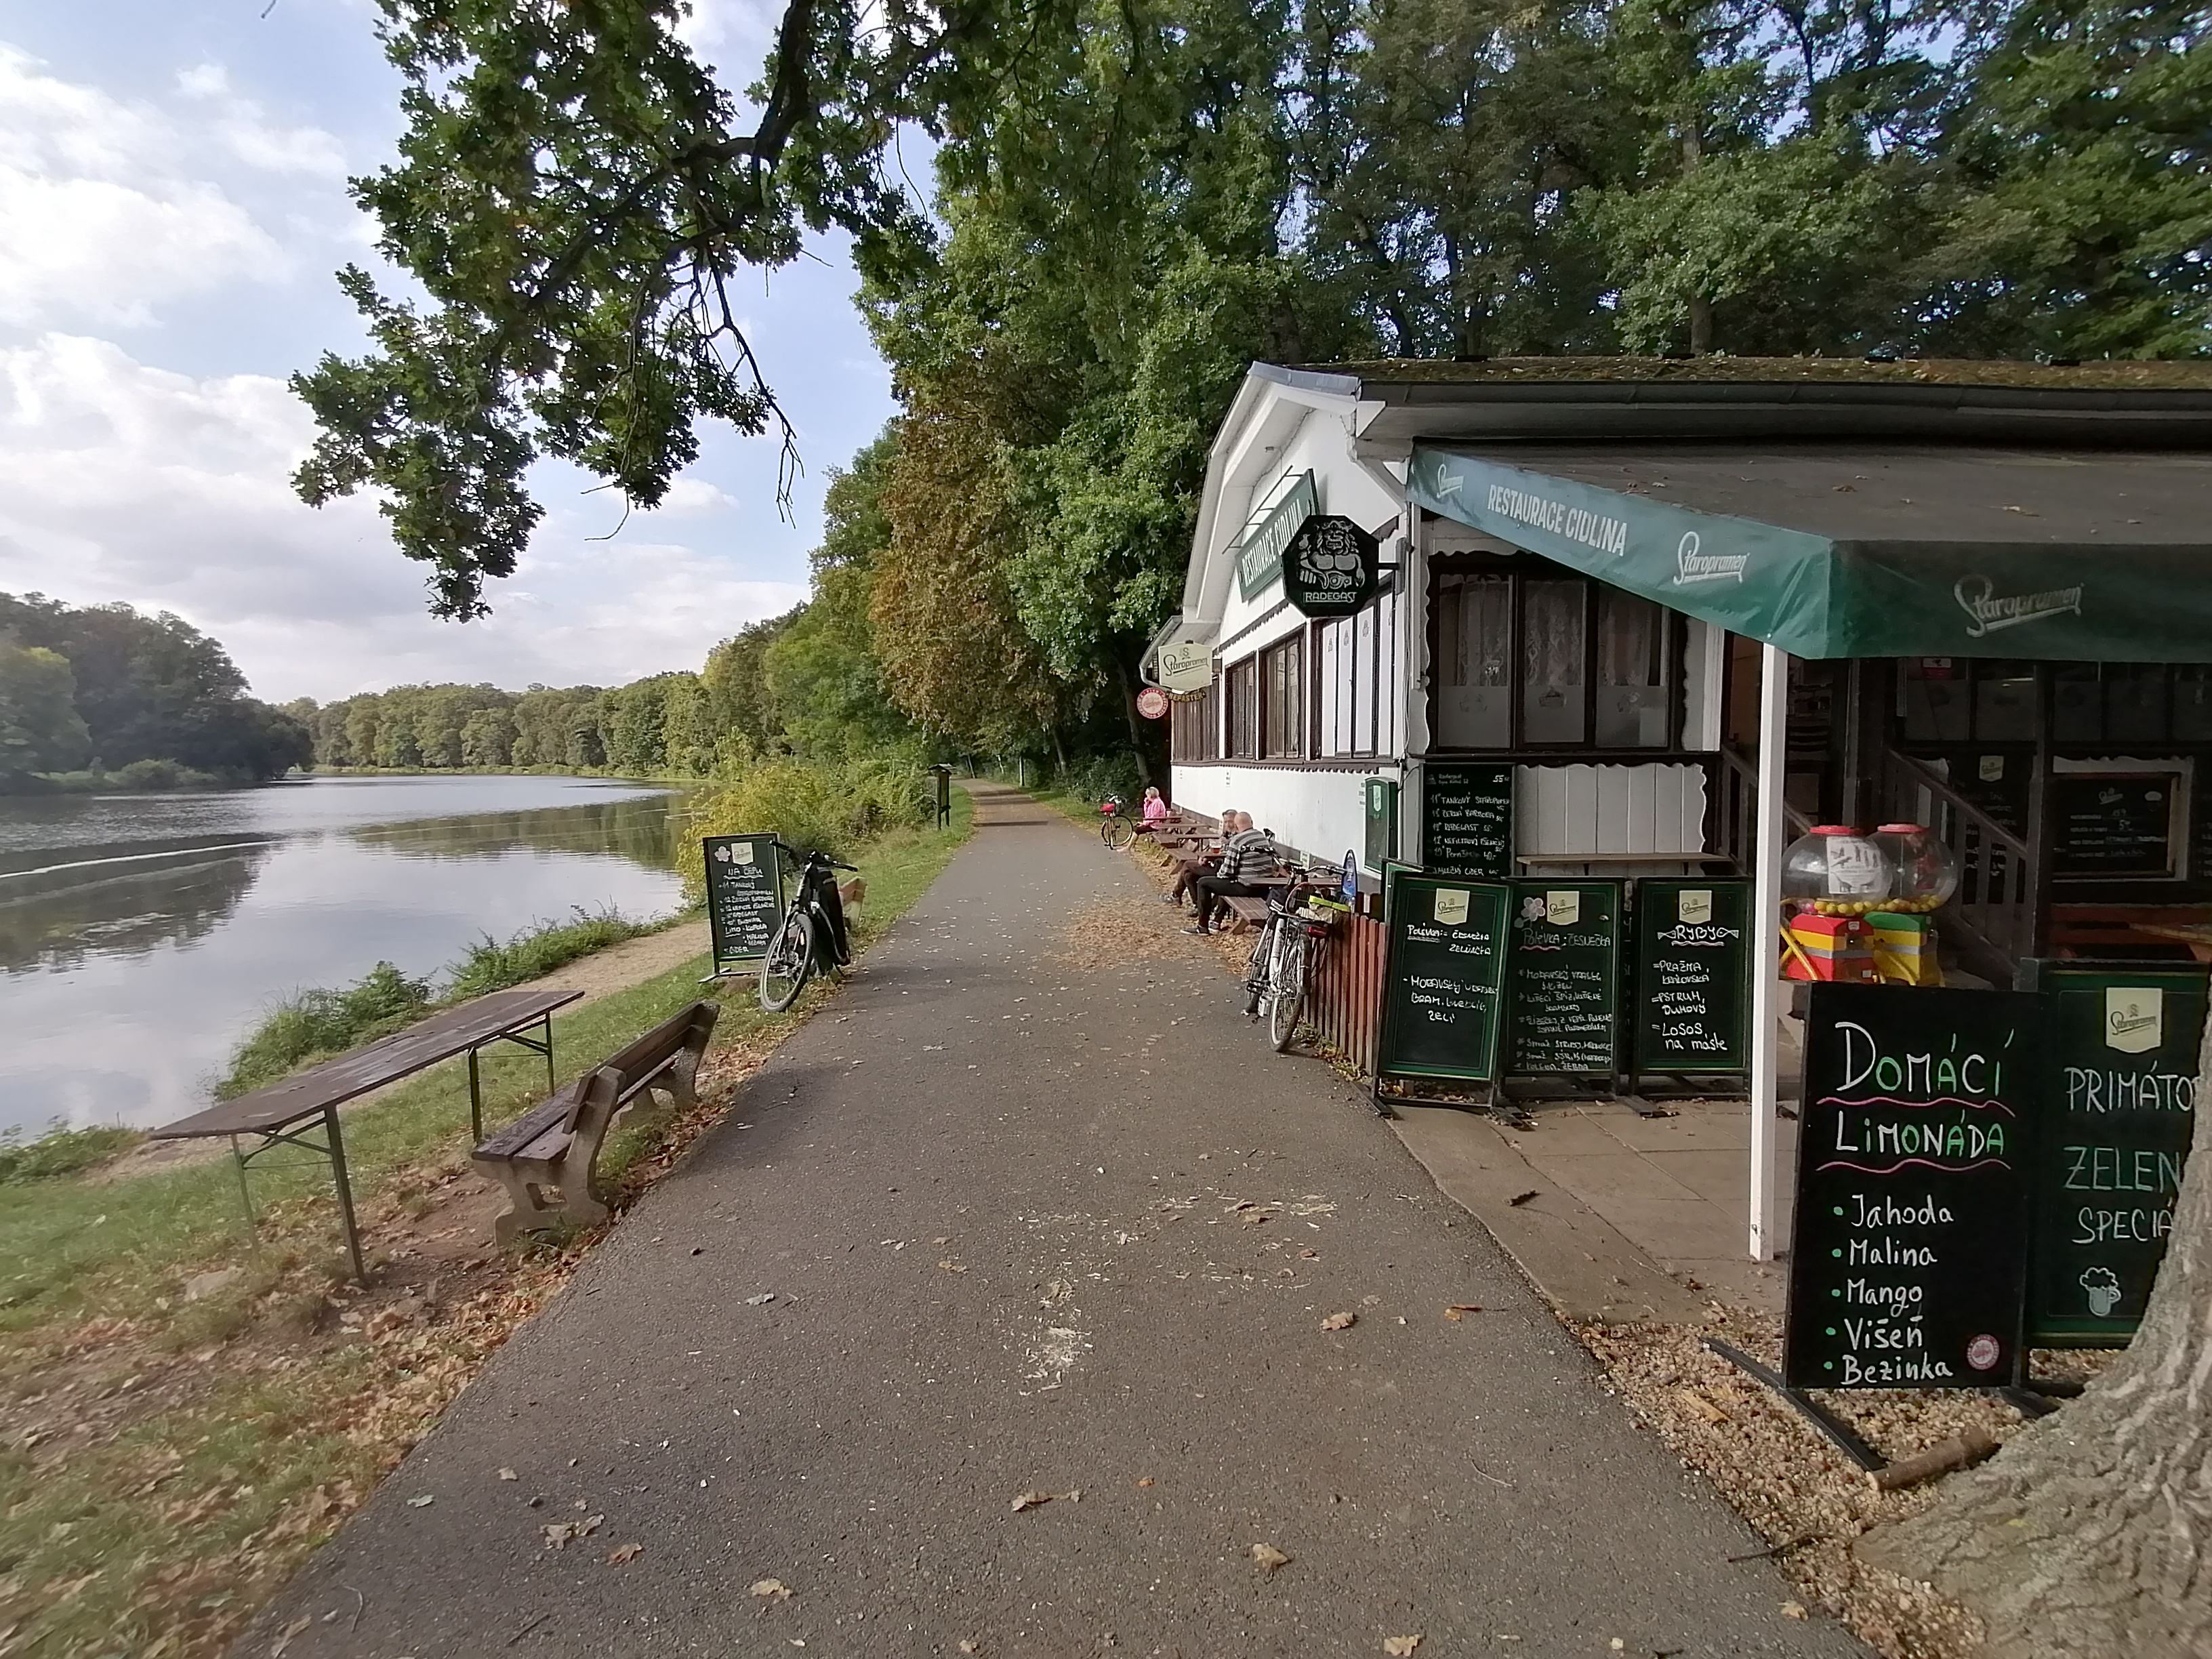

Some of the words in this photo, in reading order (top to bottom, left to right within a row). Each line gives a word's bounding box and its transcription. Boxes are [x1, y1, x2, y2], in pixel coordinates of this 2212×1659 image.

[1488, 483, 1563, 535] RESTAURACE
[1565, 508, 1628, 557] CIDLINA
[1242, 527, 1276, 588] RESTAURACE
[1673, 531, 1750, 586] Staropramen
[1305, 592, 1357, 603] RADEGAST
[1954, 573, 2085, 638] Staropramen
[1163, 655, 1209, 676] Staropramen
[1441, 792, 1471, 804] TANKOVÝ
[1675, 924, 1716, 941] RYBY
[1835, 1021, 2015, 1097] DOMÁCÍ
[2063, 1059, 2194, 1113] PRIMÁTO
[2062, 1146, 2182, 1193] ZELEN
[1850, 1193, 1954, 1229] Jahoda
[2071, 1197, 2174, 1244] SPECIÁ
[1849, 1236, 1938, 1267] Malina
[1847, 1278, 1923, 1317] Mango
[1843, 1315, 1923, 1351] Višeň
[1841, 1351, 1954, 1385] Bezinka
